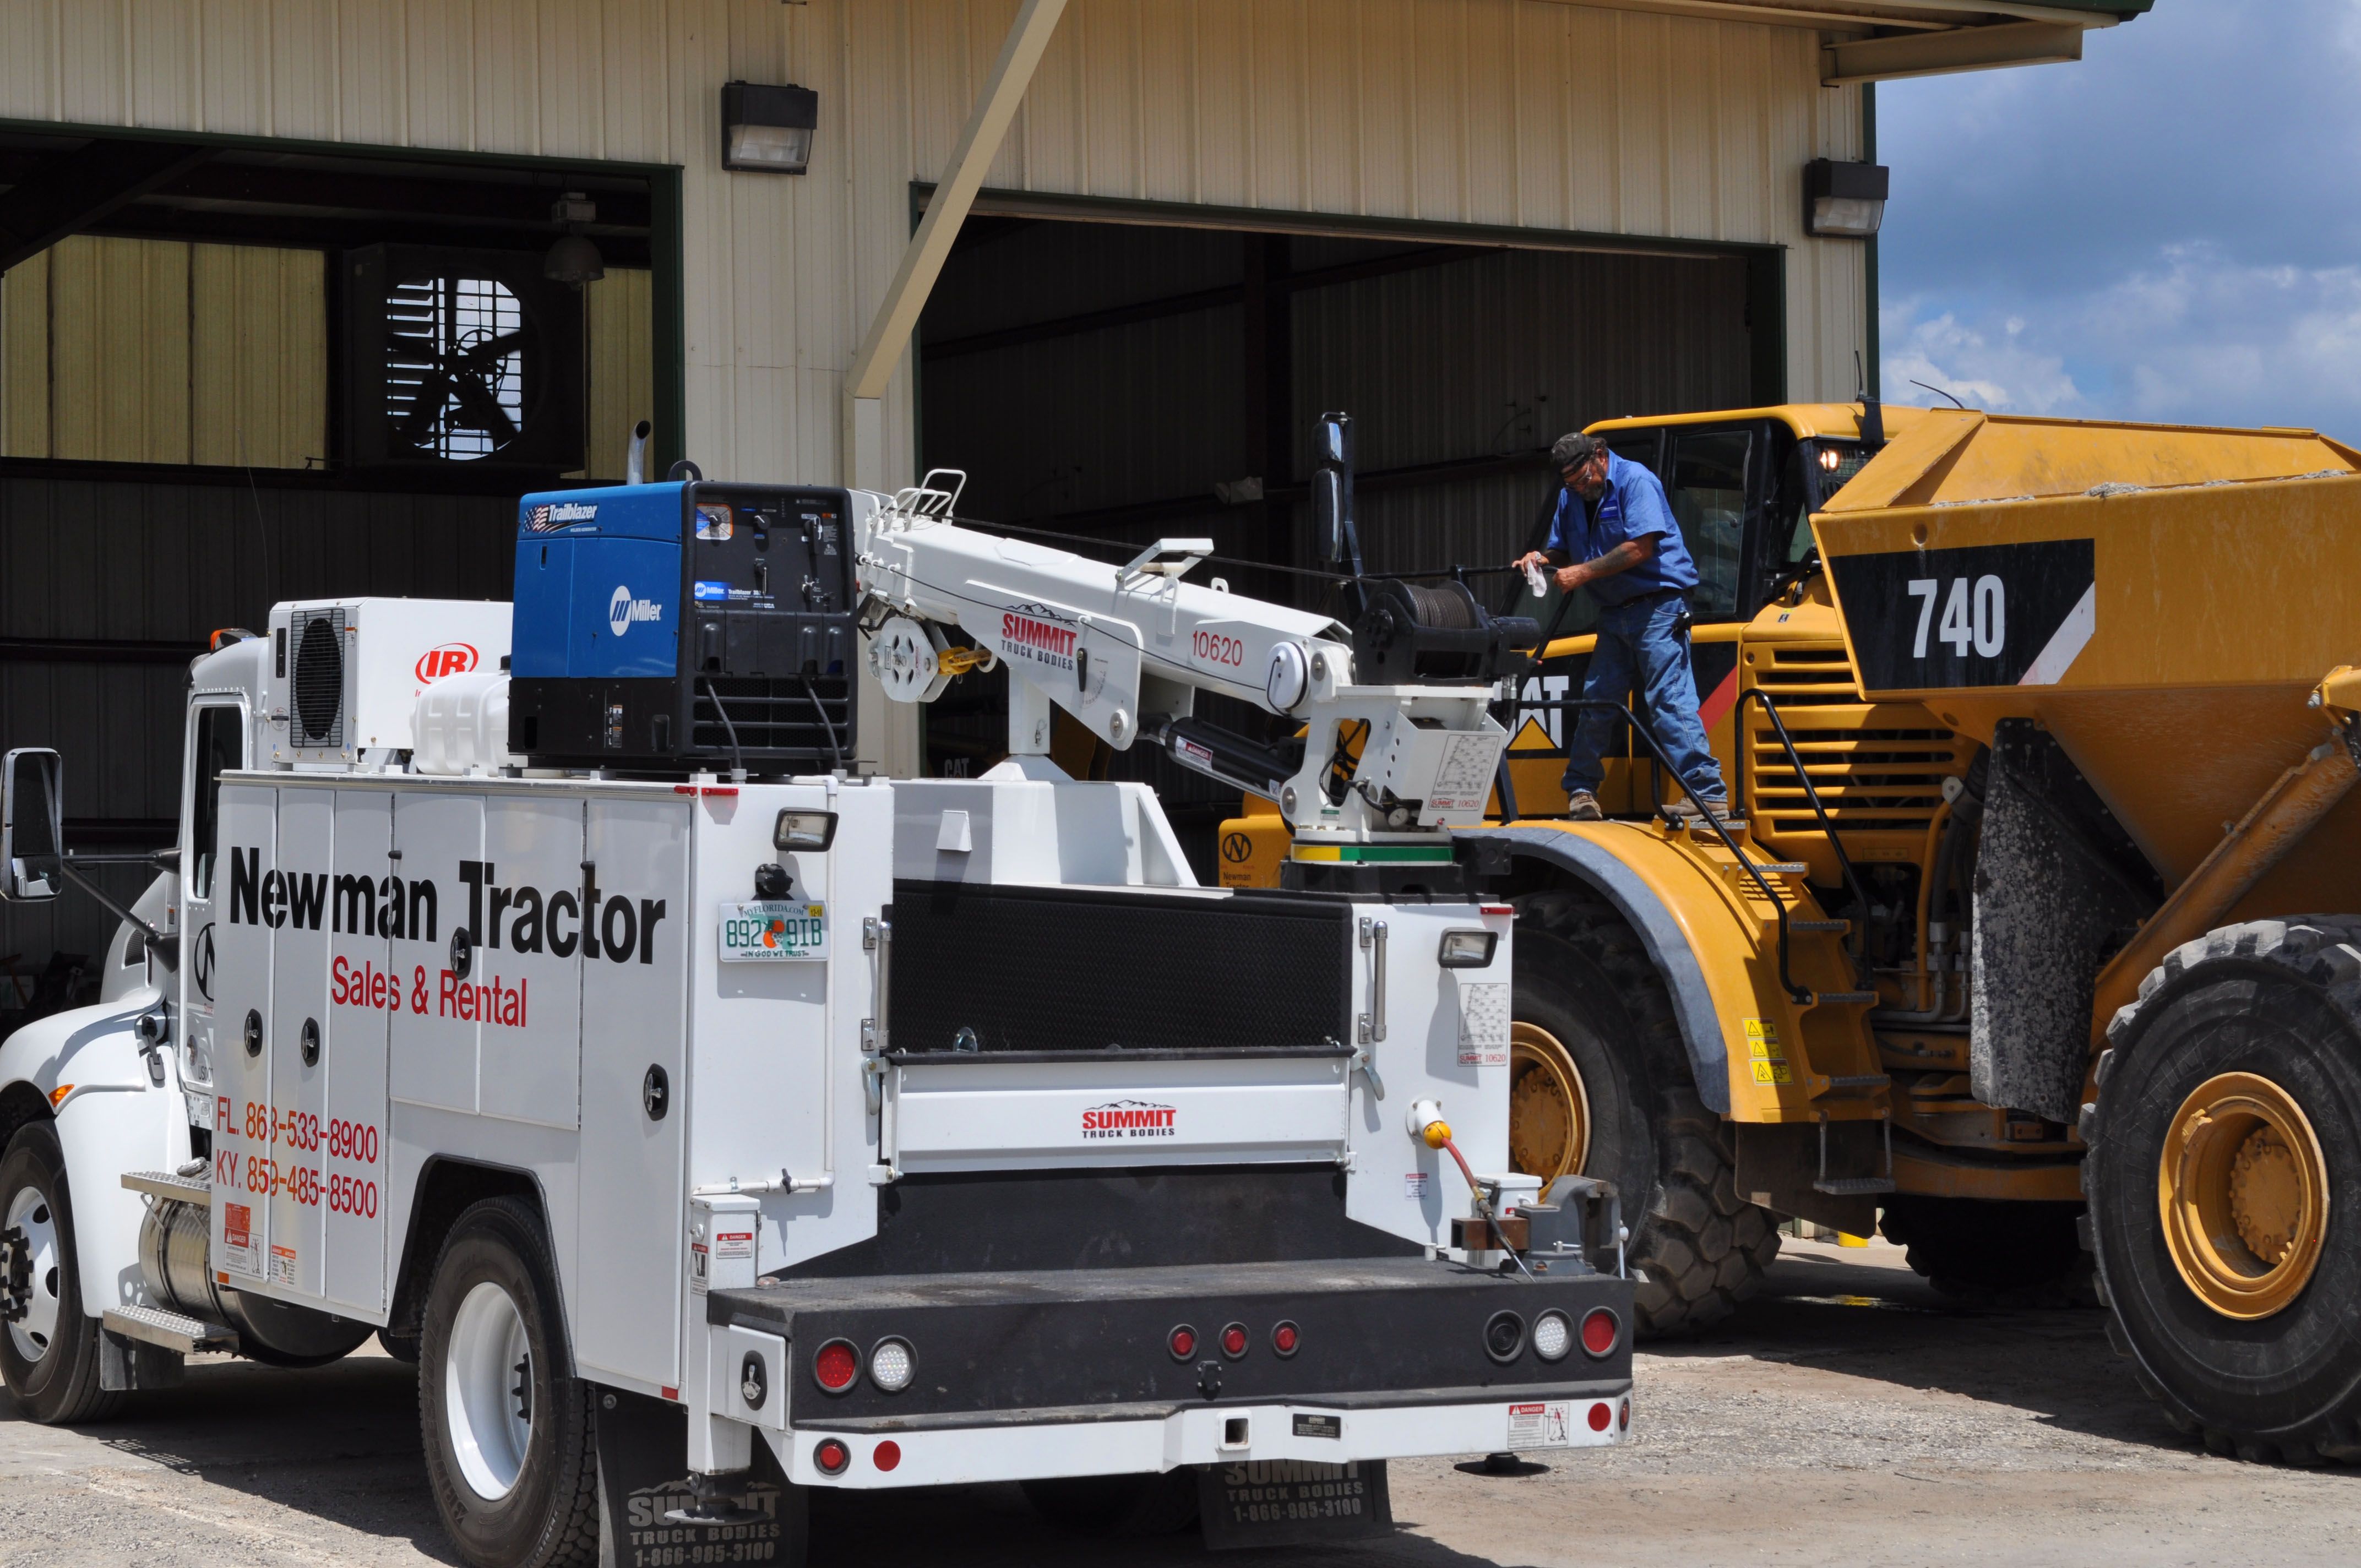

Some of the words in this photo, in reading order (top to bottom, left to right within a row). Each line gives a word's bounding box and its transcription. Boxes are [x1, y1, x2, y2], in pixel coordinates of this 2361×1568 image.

[548, 503, 597, 522] Trailblazer
[631, 599, 662, 622] Miller
[1908, 574, 2005, 658] 740
[1003, 613, 1077, 657] SUMMIT
[1001, 639, 1032, 659] TRUCK
[1037, 650, 1073, 671] BODIES
[1193, 630, 1243, 667] 10620
[425, 651, 468, 677] IR
[944, 758, 970, 778] CAT
[1223, 872, 1252, 881] Newman
[230, 846, 438, 942] Newman
[459, 860, 666, 965] Tractor
[726, 919, 762, 948] 892
[331, 955, 401, 1012] Sales
[411, 965, 429, 1015] &
[440, 969, 527, 1027] Rental
[1485, 1054, 1506, 1063] 10620
[217, 1096, 239, 1135] FL.
[246, 1102, 378, 1164] 863-533-8900
[1082, 1109, 1177, 1130] SUMMIT
[1082, 1129, 1123, 1139] TRUCK
[1130, 1128, 1175, 1137] BODIES
[216, 1149, 241, 1189] KY.
[247, 1155, 378, 1219] 859-485-8500
[1226, 1487, 1289, 1502] TRUCK
[1298, 1481, 1364, 1499] BODIES
[628, 1490, 781, 1527] SUIT
[1233, 1497, 1362, 1522] 1-866-985-3100
[630, 1528, 697, 1545] TRUCK
[707, 1523, 781, 1541] BODIES
[634, 1542, 775, 1567] 1-866-985-3100
